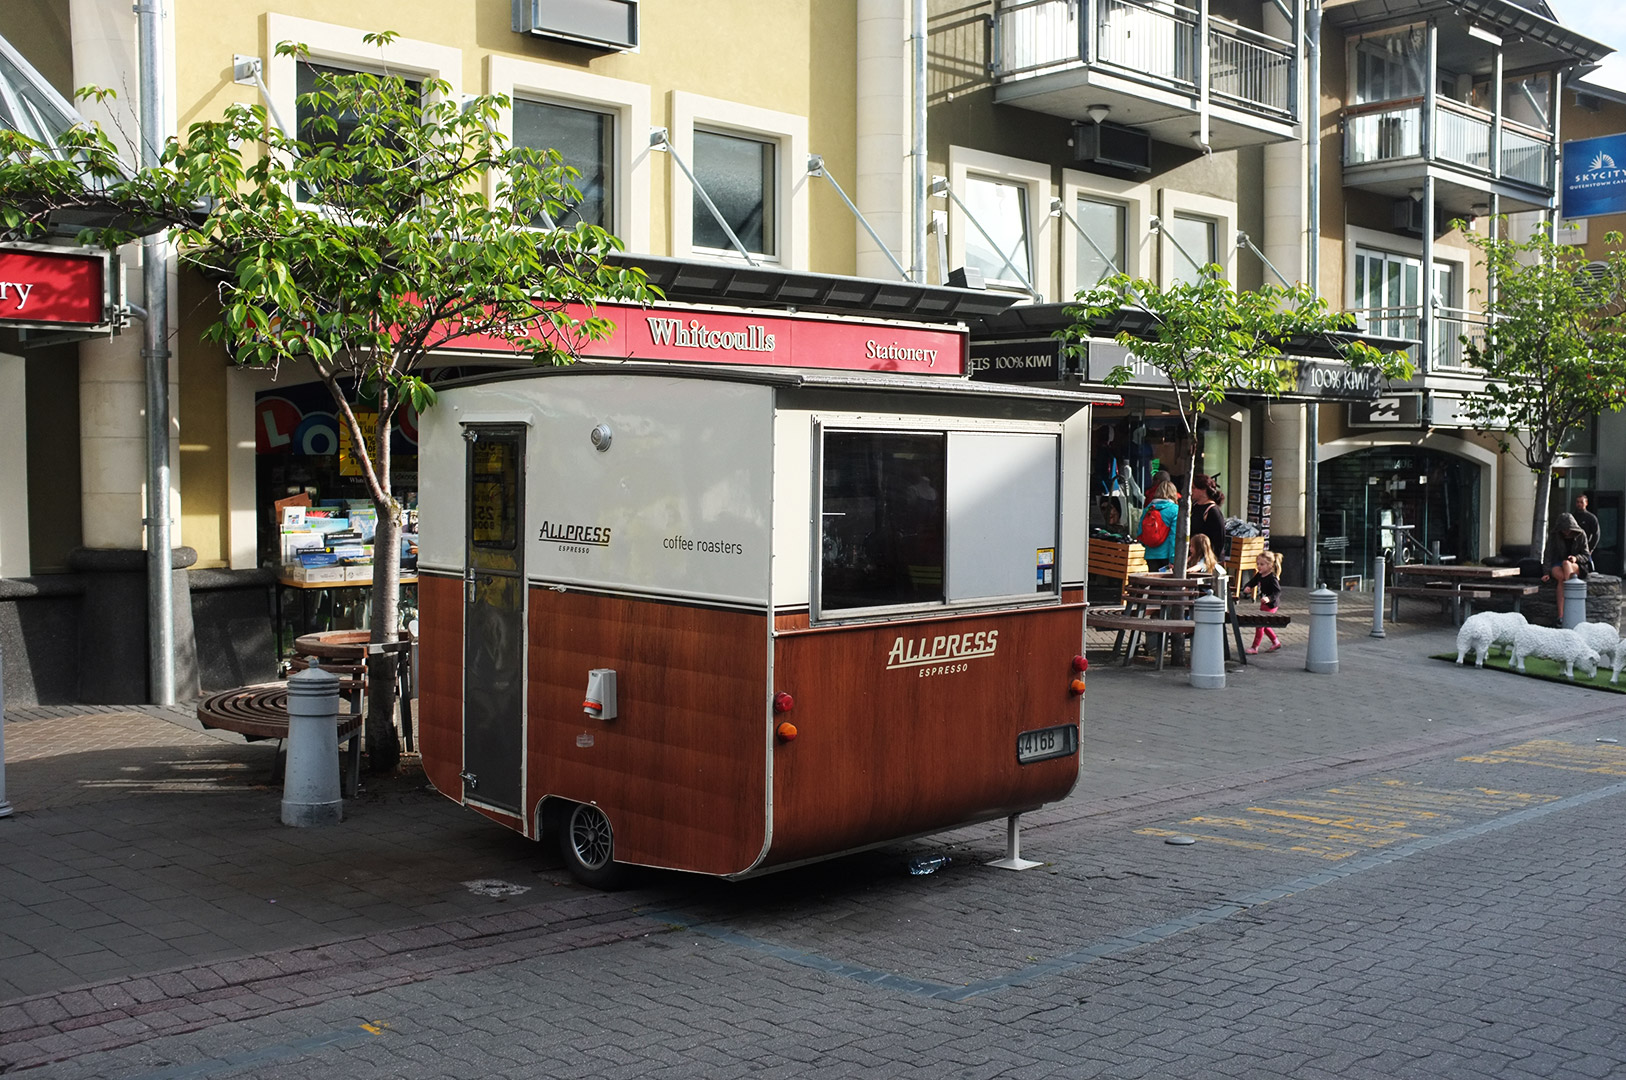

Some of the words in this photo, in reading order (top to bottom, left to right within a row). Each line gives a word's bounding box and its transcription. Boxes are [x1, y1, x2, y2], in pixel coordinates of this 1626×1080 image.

[1569, 181, 1611, 190] QUEENSTOWN
[1575, 169, 1626, 182] SKYCITY
[0, 281, 33, 310] ry
[647, 317, 776, 352] Whitcoulls
[865, 339, 938, 367] Stationery
[995, 356, 1024, 369] 100%
[1025, 355, 1052, 368] KIWI
[1311, 368, 1341, 389] 100%
[1344, 370, 1369, 390] KIWI
[539, 521, 612, 544] ALLPRESS
[558, 545, 590, 554] ESPRESSO
[663, 535, 694, 551] coffee
[697, 540, 743, 555] roasters
[888, 630, 999, 665] ALLPRESS
[919, 663, 968, 678] ESPRESSO
